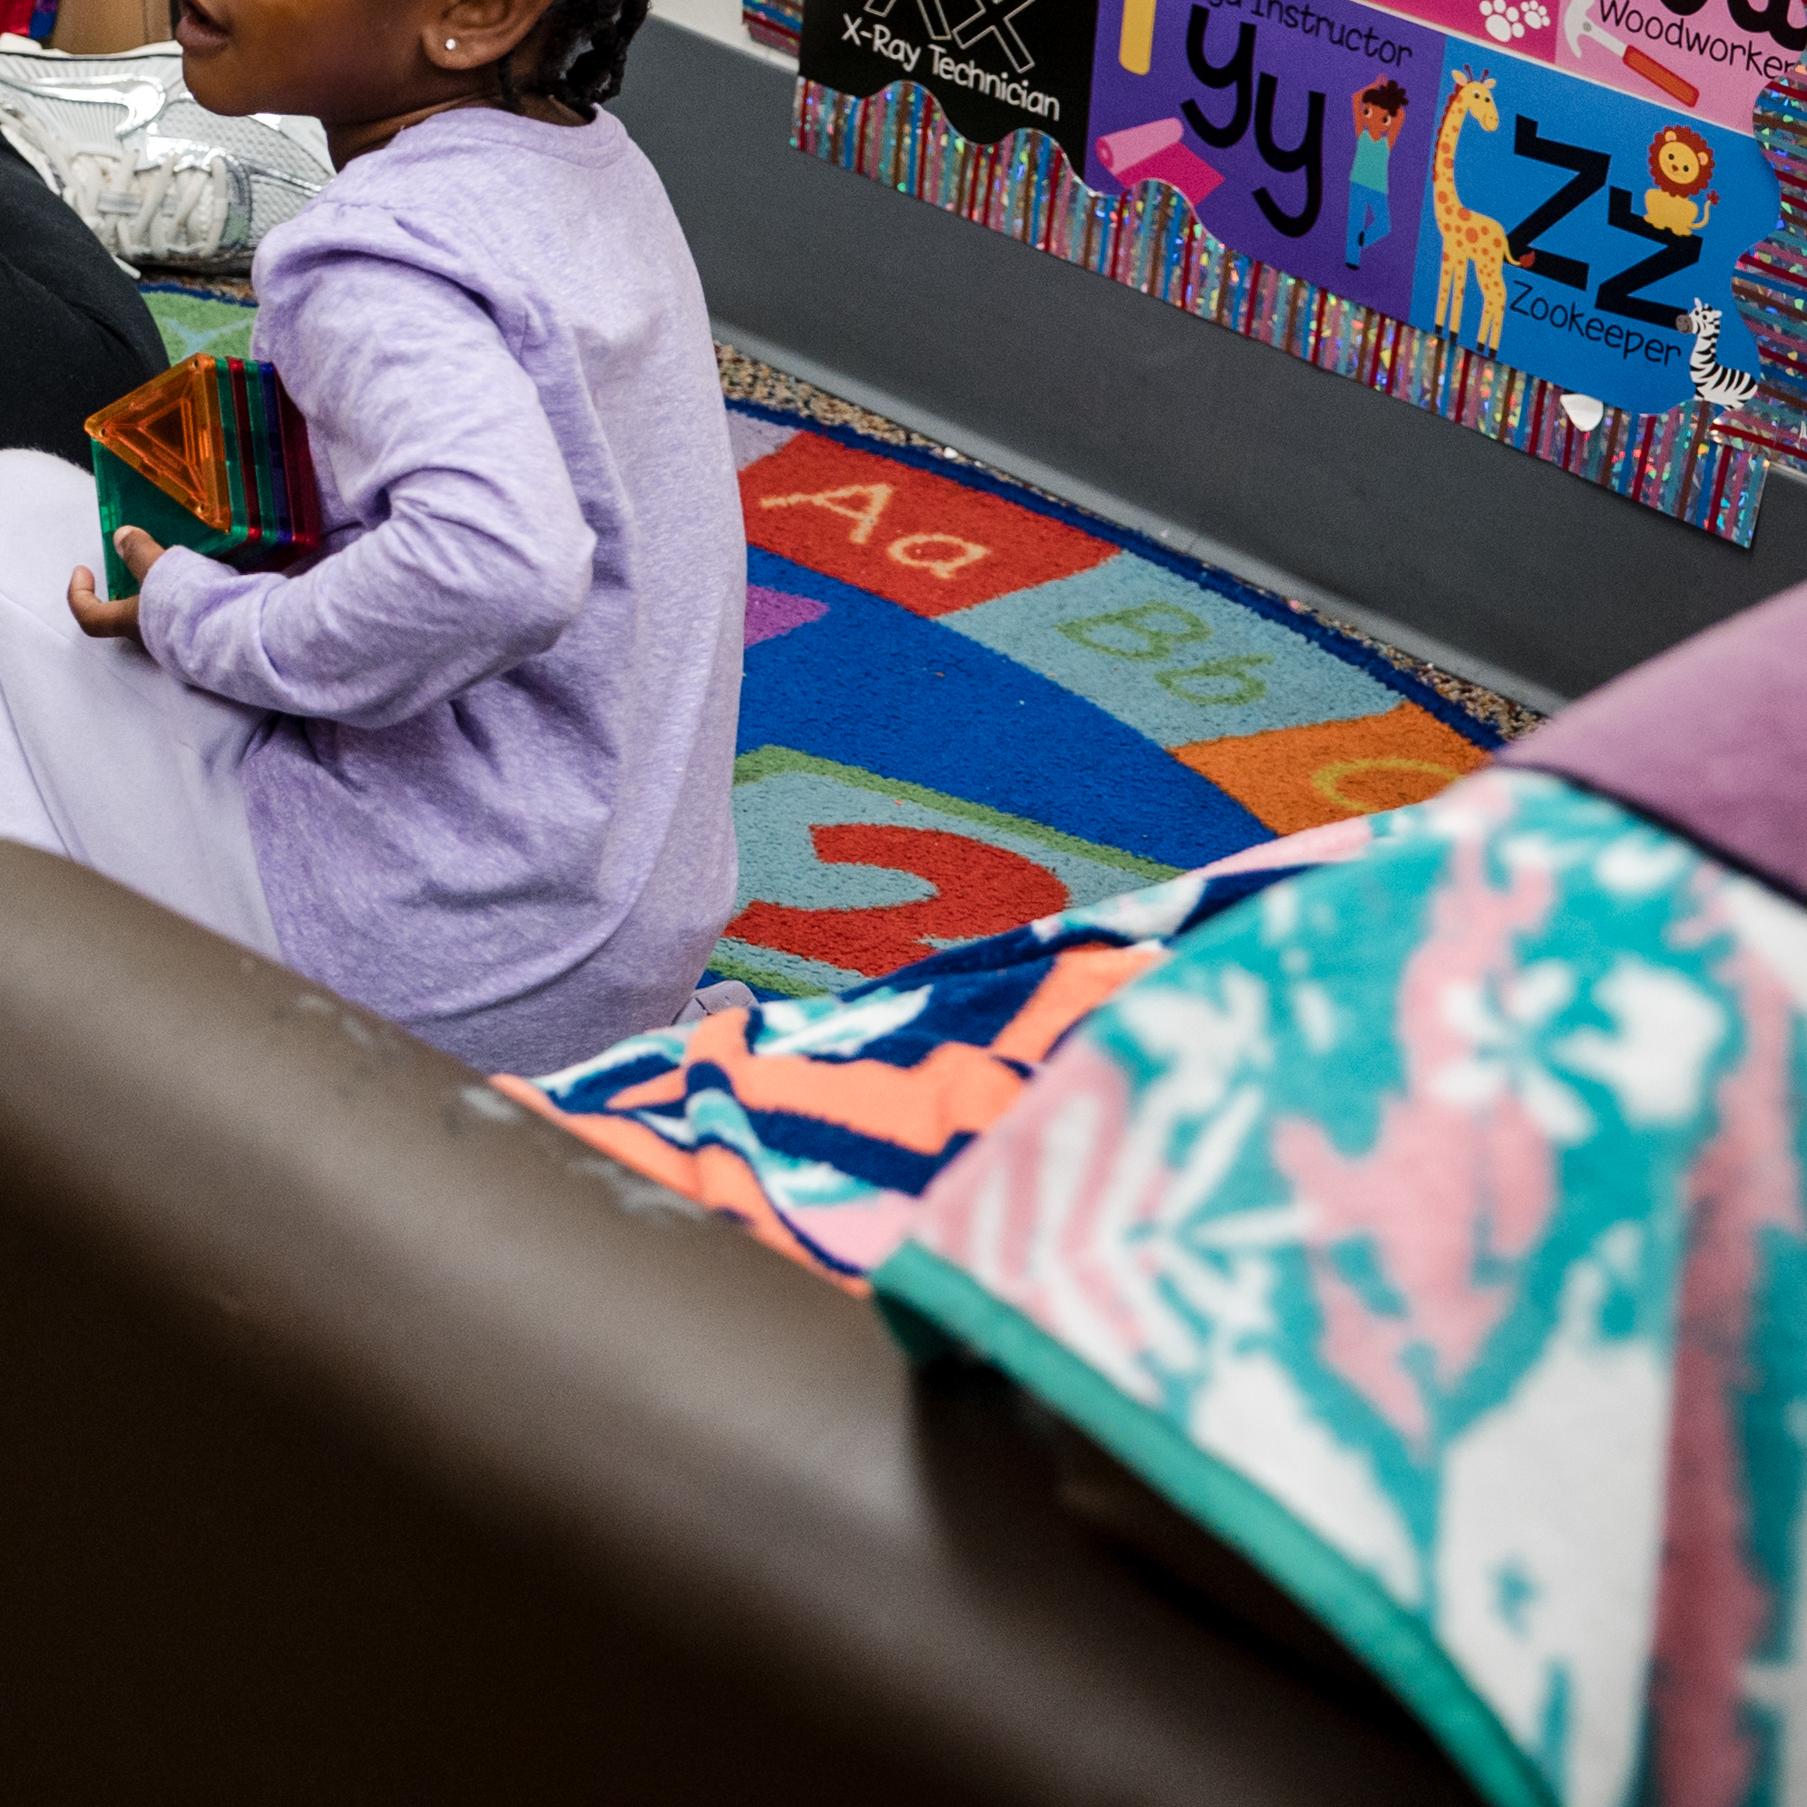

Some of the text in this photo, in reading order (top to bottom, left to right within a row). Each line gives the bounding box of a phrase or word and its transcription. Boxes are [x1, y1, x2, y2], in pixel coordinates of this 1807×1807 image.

[842, 14, 1061, 122] X-Ray Technician
[1511, 114, 1704, 321] Zz
[1509, 281, 1682, 368] Zookeeper
[759, 480, 988, 578] Aa
[1058, 601, 1277, 706] Bb
